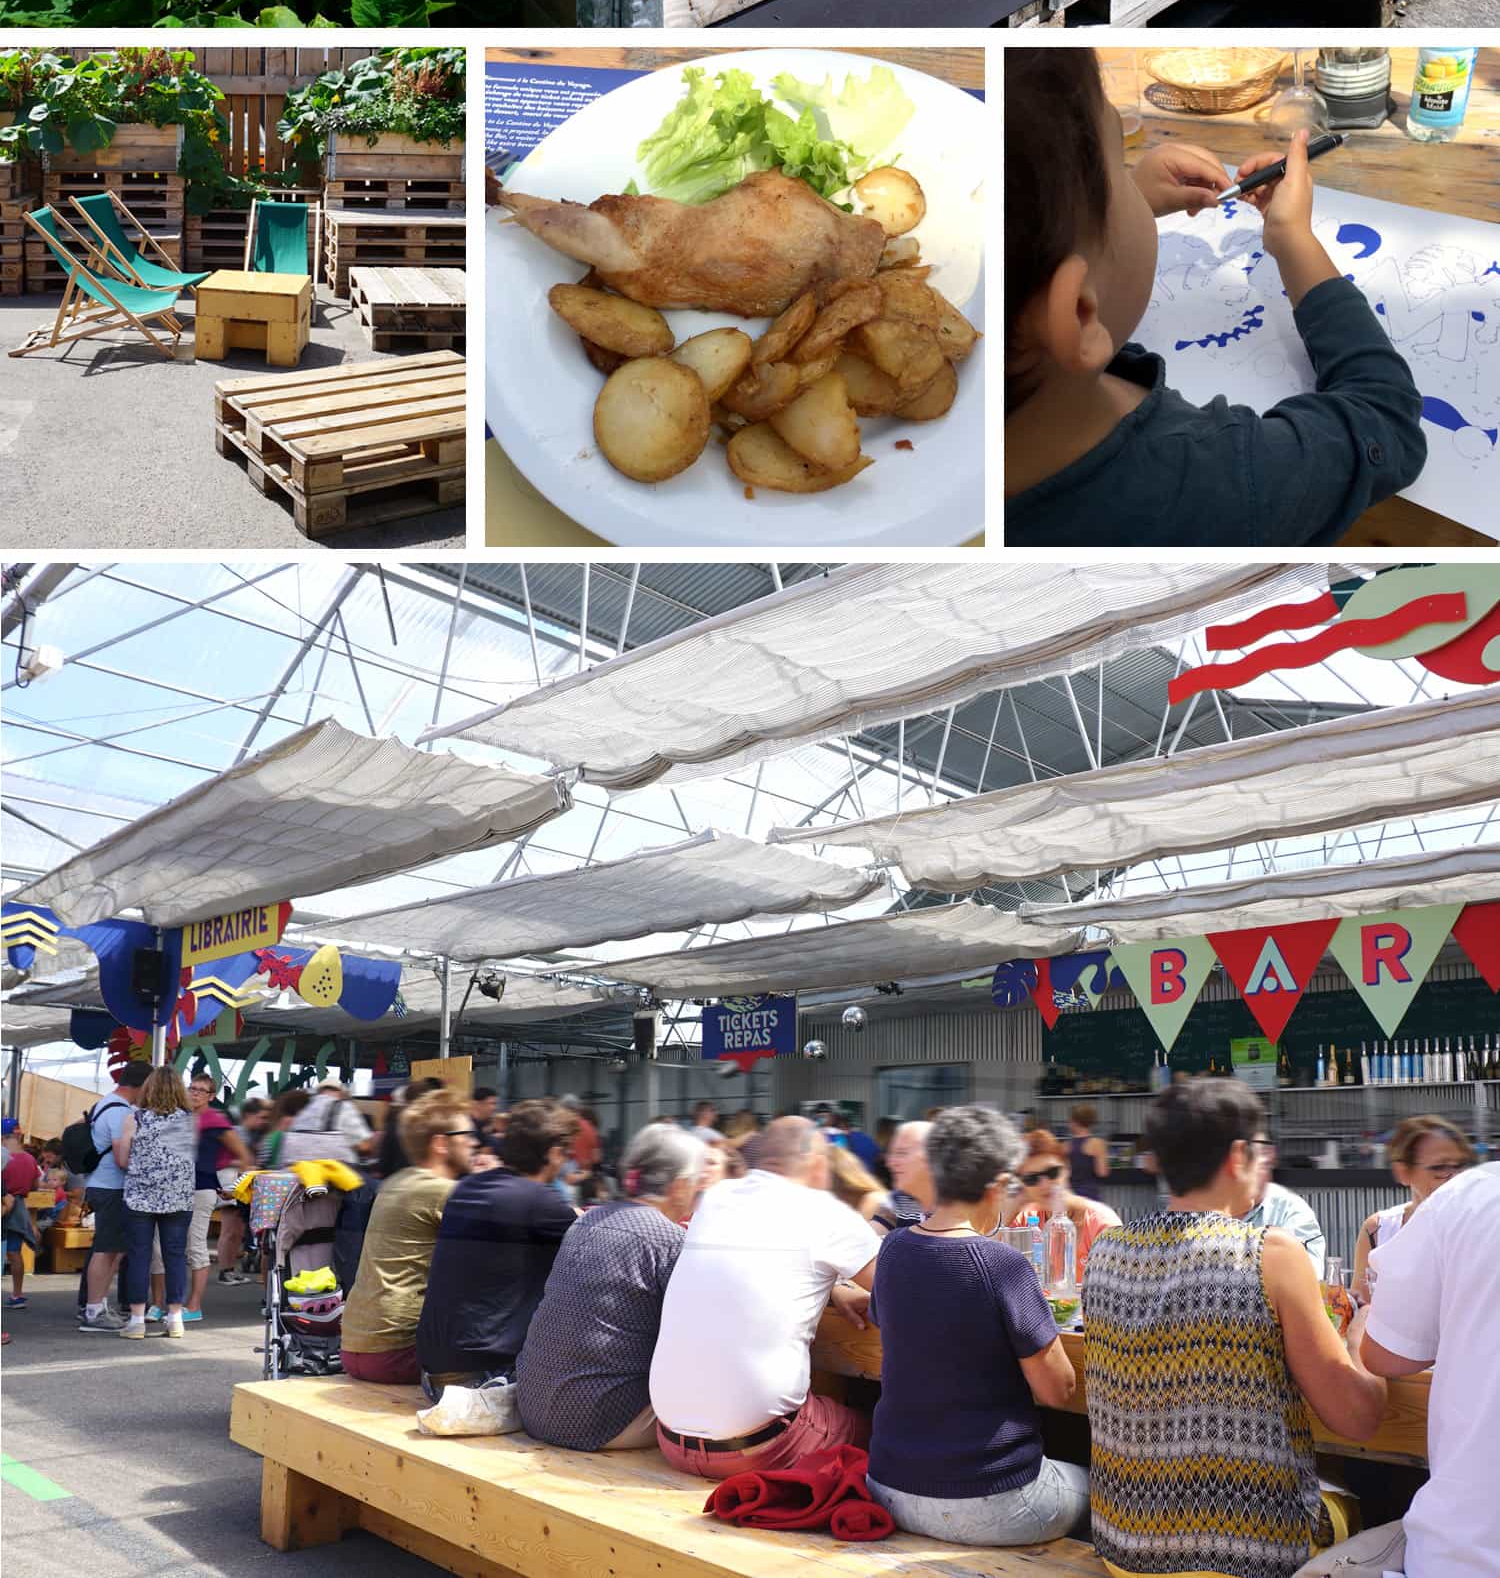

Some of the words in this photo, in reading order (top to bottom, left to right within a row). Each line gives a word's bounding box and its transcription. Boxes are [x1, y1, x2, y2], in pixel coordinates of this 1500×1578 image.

[190, 906, 268, 953] LIBRAIRIE
[1151, 922, 1412, 1005] BAR
[718, 1009, 778, 1032] TICKETS
[724, 1028, 771, 1049] REPAS
